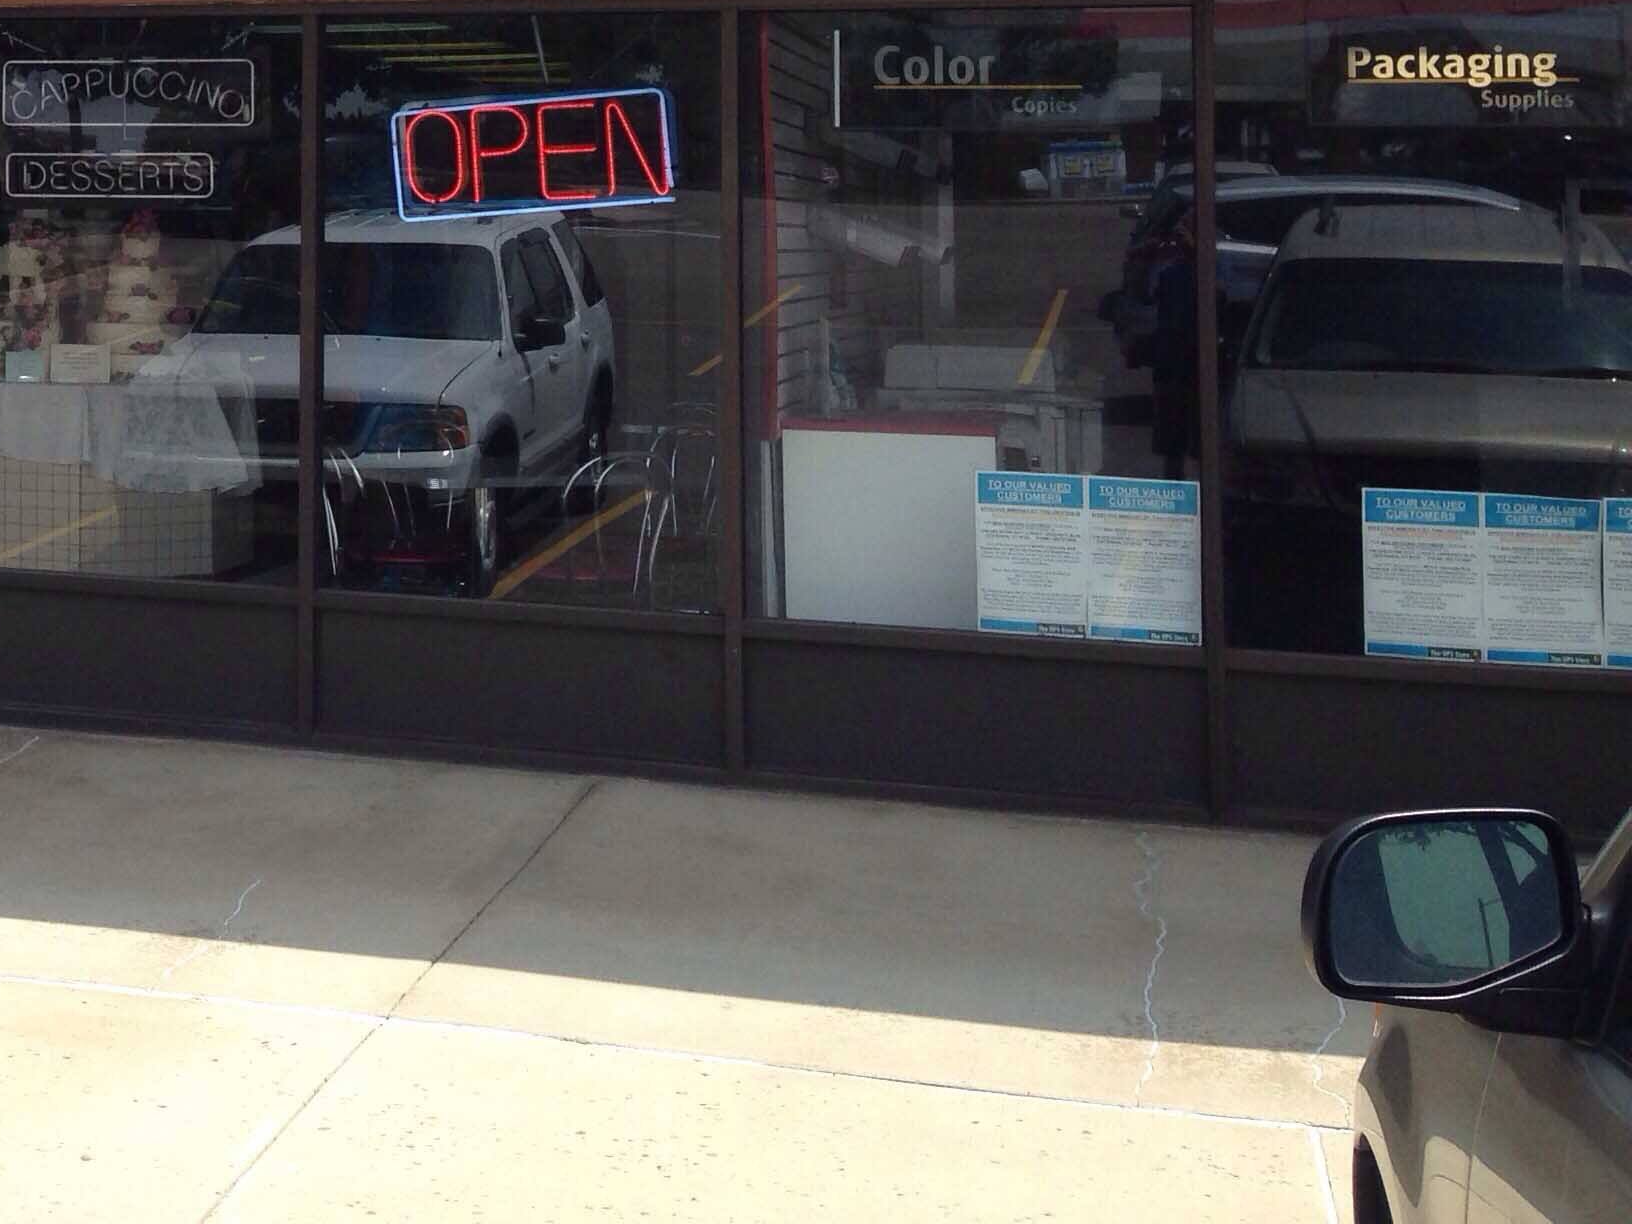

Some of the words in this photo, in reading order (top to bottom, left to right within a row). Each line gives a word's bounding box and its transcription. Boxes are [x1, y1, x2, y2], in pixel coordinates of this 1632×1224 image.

[874, 45, 996, 84] Color
[1347, 44, 1557, 87] Packaging
[11, 67, 245, 119] CAPPUCCINO
[1481, 89, 1574, 112] Supplies
[1011, 96, 1078, 117] Copies
[404, 102, 670, 205] OPEN
[23, 160, 204, 192] DESSERTS
[988, 479, 1003, 490] TO
[1005, 480, 1028, 490] OUR
[1030, 482, 1071, 493] VALUED
[1099, 485, 1115, 496] TO
[1117, 486, 1139, 497] OUR
[1142, 488, 1184, 499] VALUED
[997, 492, 1062, 504] CUSTOMERS
[1109, 497, 1175, 509] CUSTOMERS
[1376, 497, 1390, 508] TO
[1393, 498, 1418, 508] OUR
[1421, 499, 1465, 511] VALUED
[1386, 509, 1456, 522] CUSTOMERS
[1496, 502, 1511, 513] TO
[1514, 503, 1538, 514] OUR
[1540, 505, 1586, 517] VALUED
[1505, 515, 1575, 528] CUSTOMERS
